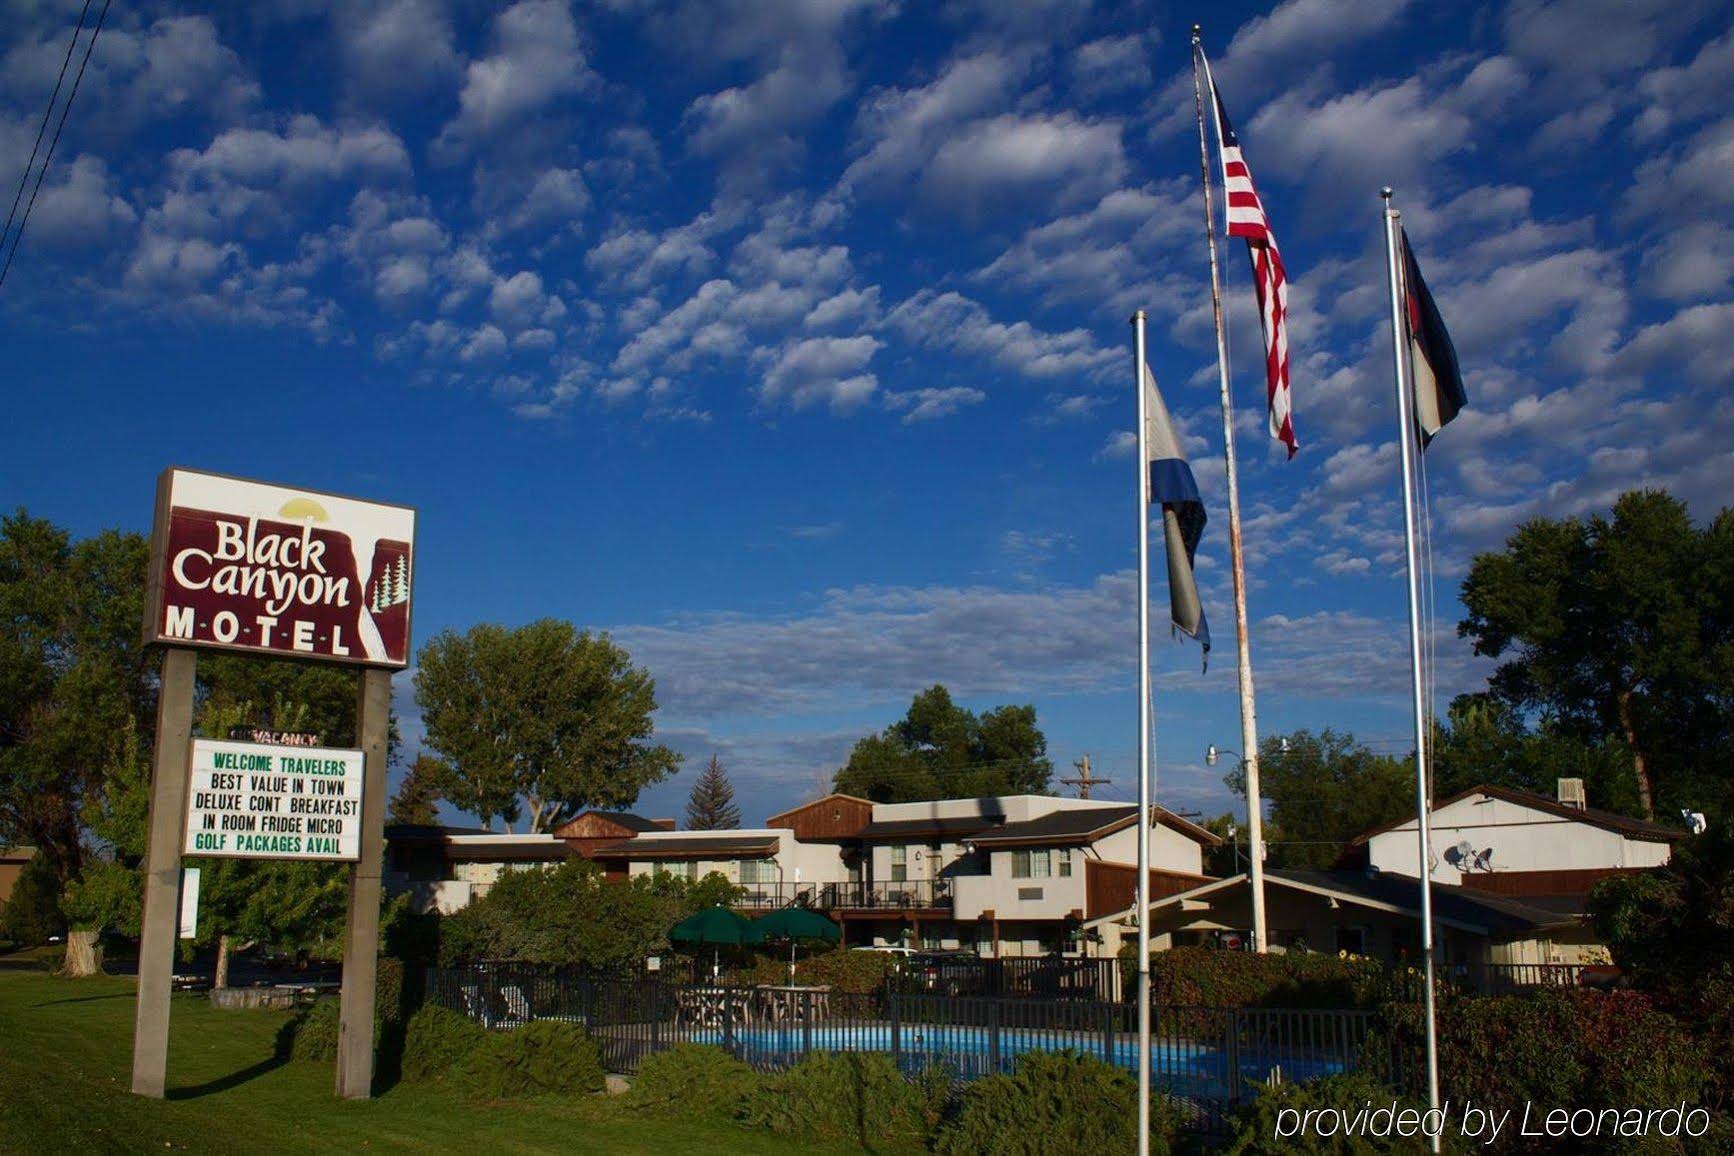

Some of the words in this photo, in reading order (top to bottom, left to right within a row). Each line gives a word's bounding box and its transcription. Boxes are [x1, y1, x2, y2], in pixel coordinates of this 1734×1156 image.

[212, 516, 327, 574] Black
[172, 548, 350, 616] Canyon
[252, 728, 318, 746] VACANCY
[214, 752, 272, 772] WELCOME
[280, 757, 346, 776] TRAVELERS
[211, 773, 243, 790] BEST
[251, 775, 288, 793] VALUE
[292, 777, 304, 794] IN
[311, 779, 345, 796] TOWN
[196, 793, 241, 810] DELUXE
[250, 795, 281, 812] CONT
[291, 798, 358, 816] BREAKFAST
[203, 814, 215, 830] IN
[222, 814, 255, 831] ROOM
[261, 816, 302, 833] FRIDGE
[307, 818, 342, 834] MICRO
[196, 833, 227, 850] GOLF
[236, 835, 302, 852] PACKAGES
[307, 837, 342, 854] AVAIL
